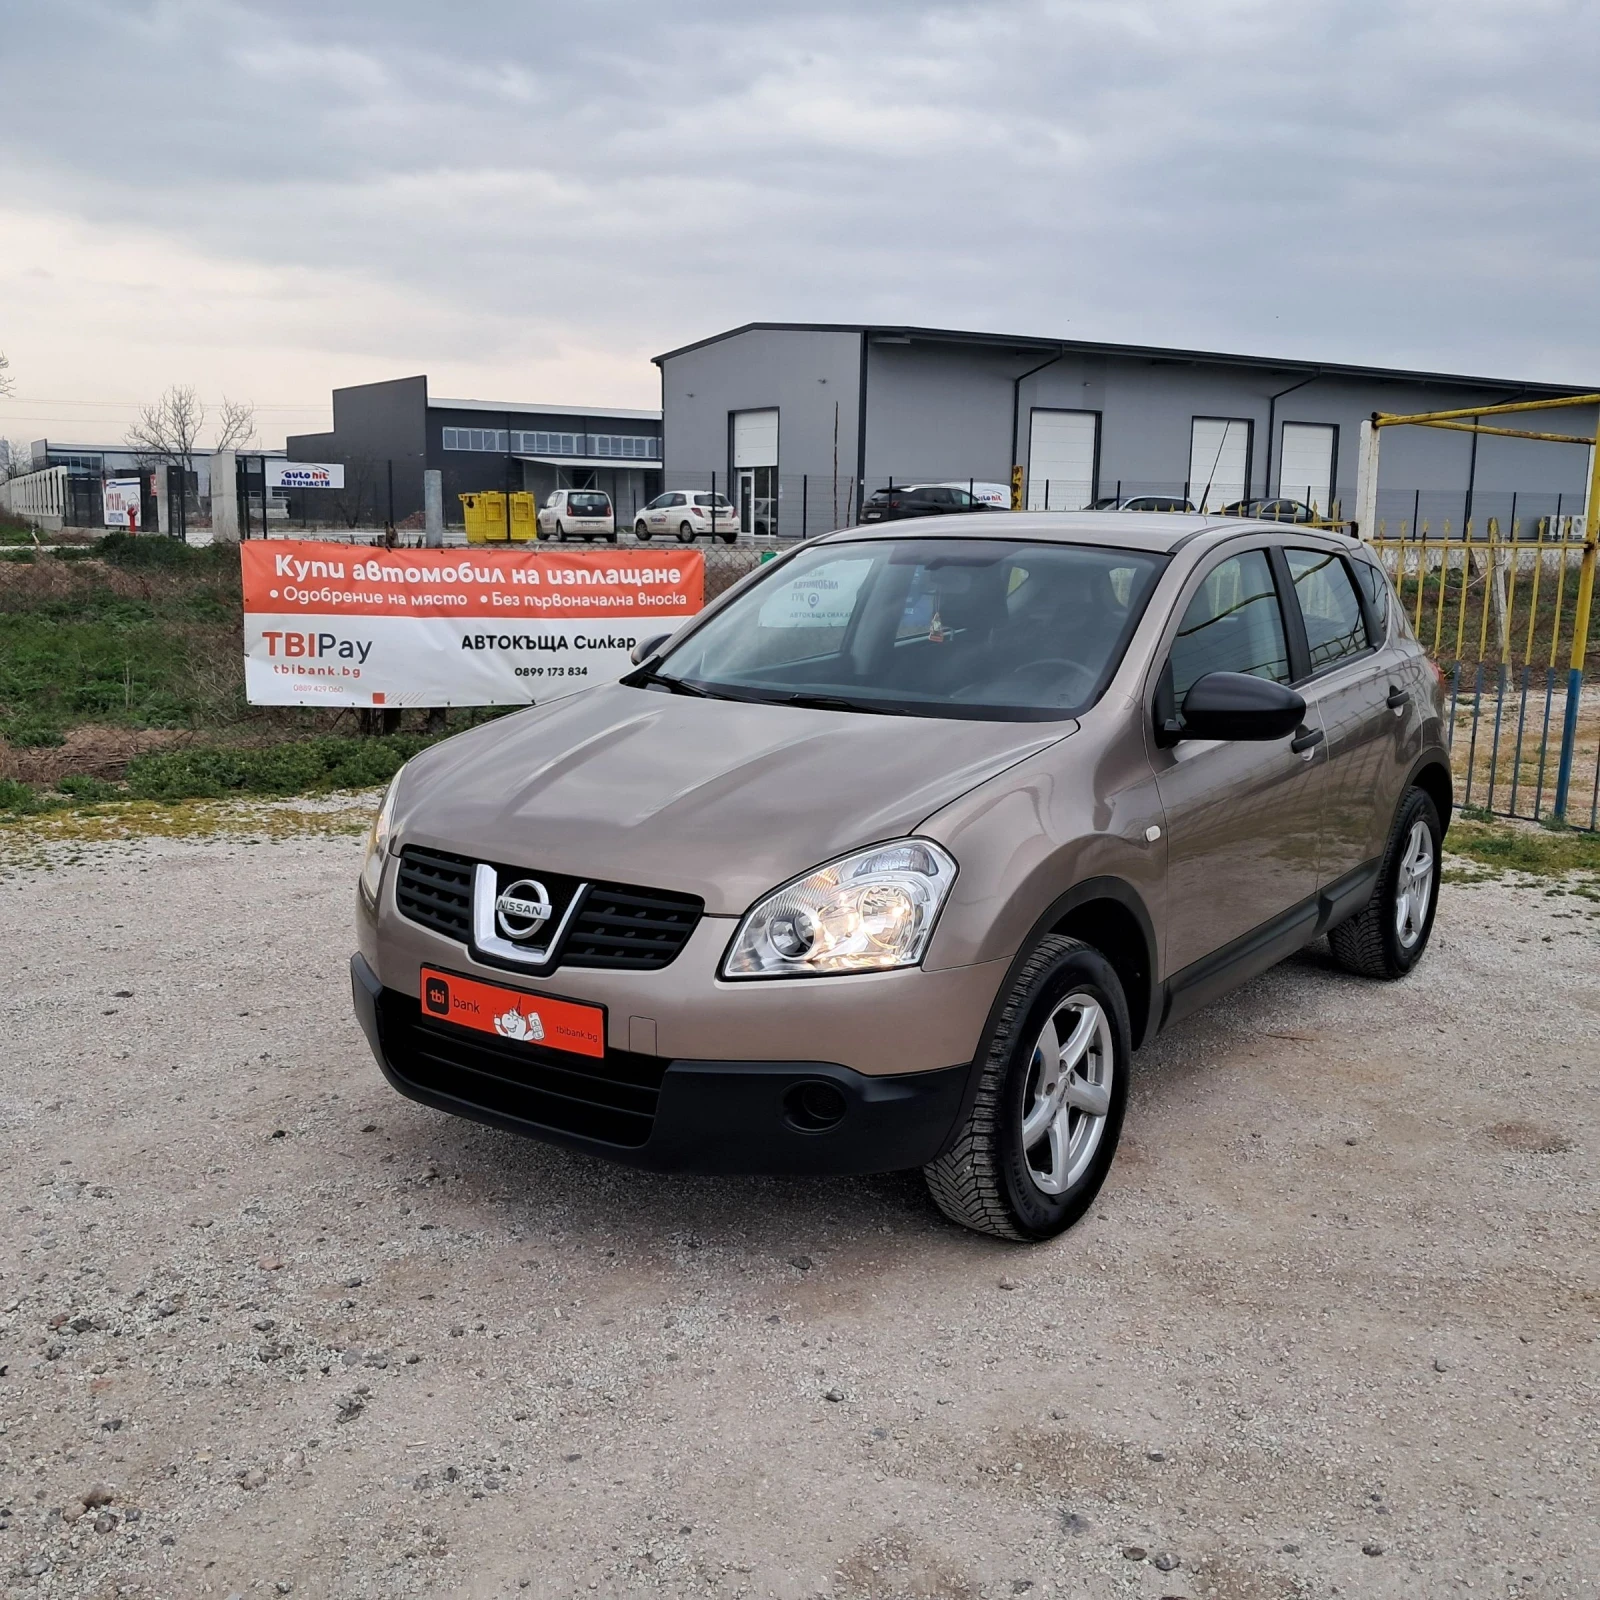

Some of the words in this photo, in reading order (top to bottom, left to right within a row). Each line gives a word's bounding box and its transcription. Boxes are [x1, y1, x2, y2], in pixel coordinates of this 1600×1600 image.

[281, 479, 331, 487] АВТОЧАСТИ
[275, 554, 345, 582] Купи
[352, 561, 505, 584] автомобил
[511, 569, 540, 585] на
[547, 567, 681, 586] изплащане
[283, 586, 384, 605] Одобрение
[388, 593, 407, 606] на
[411, 594, 468, 606] място
[492, 592, 520, 606] Без
[524, 595, 634, 609] първоначална
[638, 591, 687, 606] вноска
[262, 631, 373, 664] TBIPay
[461, 635, 568, 652] АВТОКЪЩА
[574, 634, 637, 652] Силкар
[273, 664, 361, 679] tbibank.bg
[514, 667, 544, 676] 0899
[547, 667, 565, 676] 173
[567, 667, 588, 676] 834
[313, 684, 327, 693] 429
[328, 685, 344, 693] 060
[498, 899, 543, 916] NISSAN
[430, 989, 445, 1004] tbi
[453, 995, 480, 1014] bank
[556, 1026, 598, 1043] tbibank.bg
